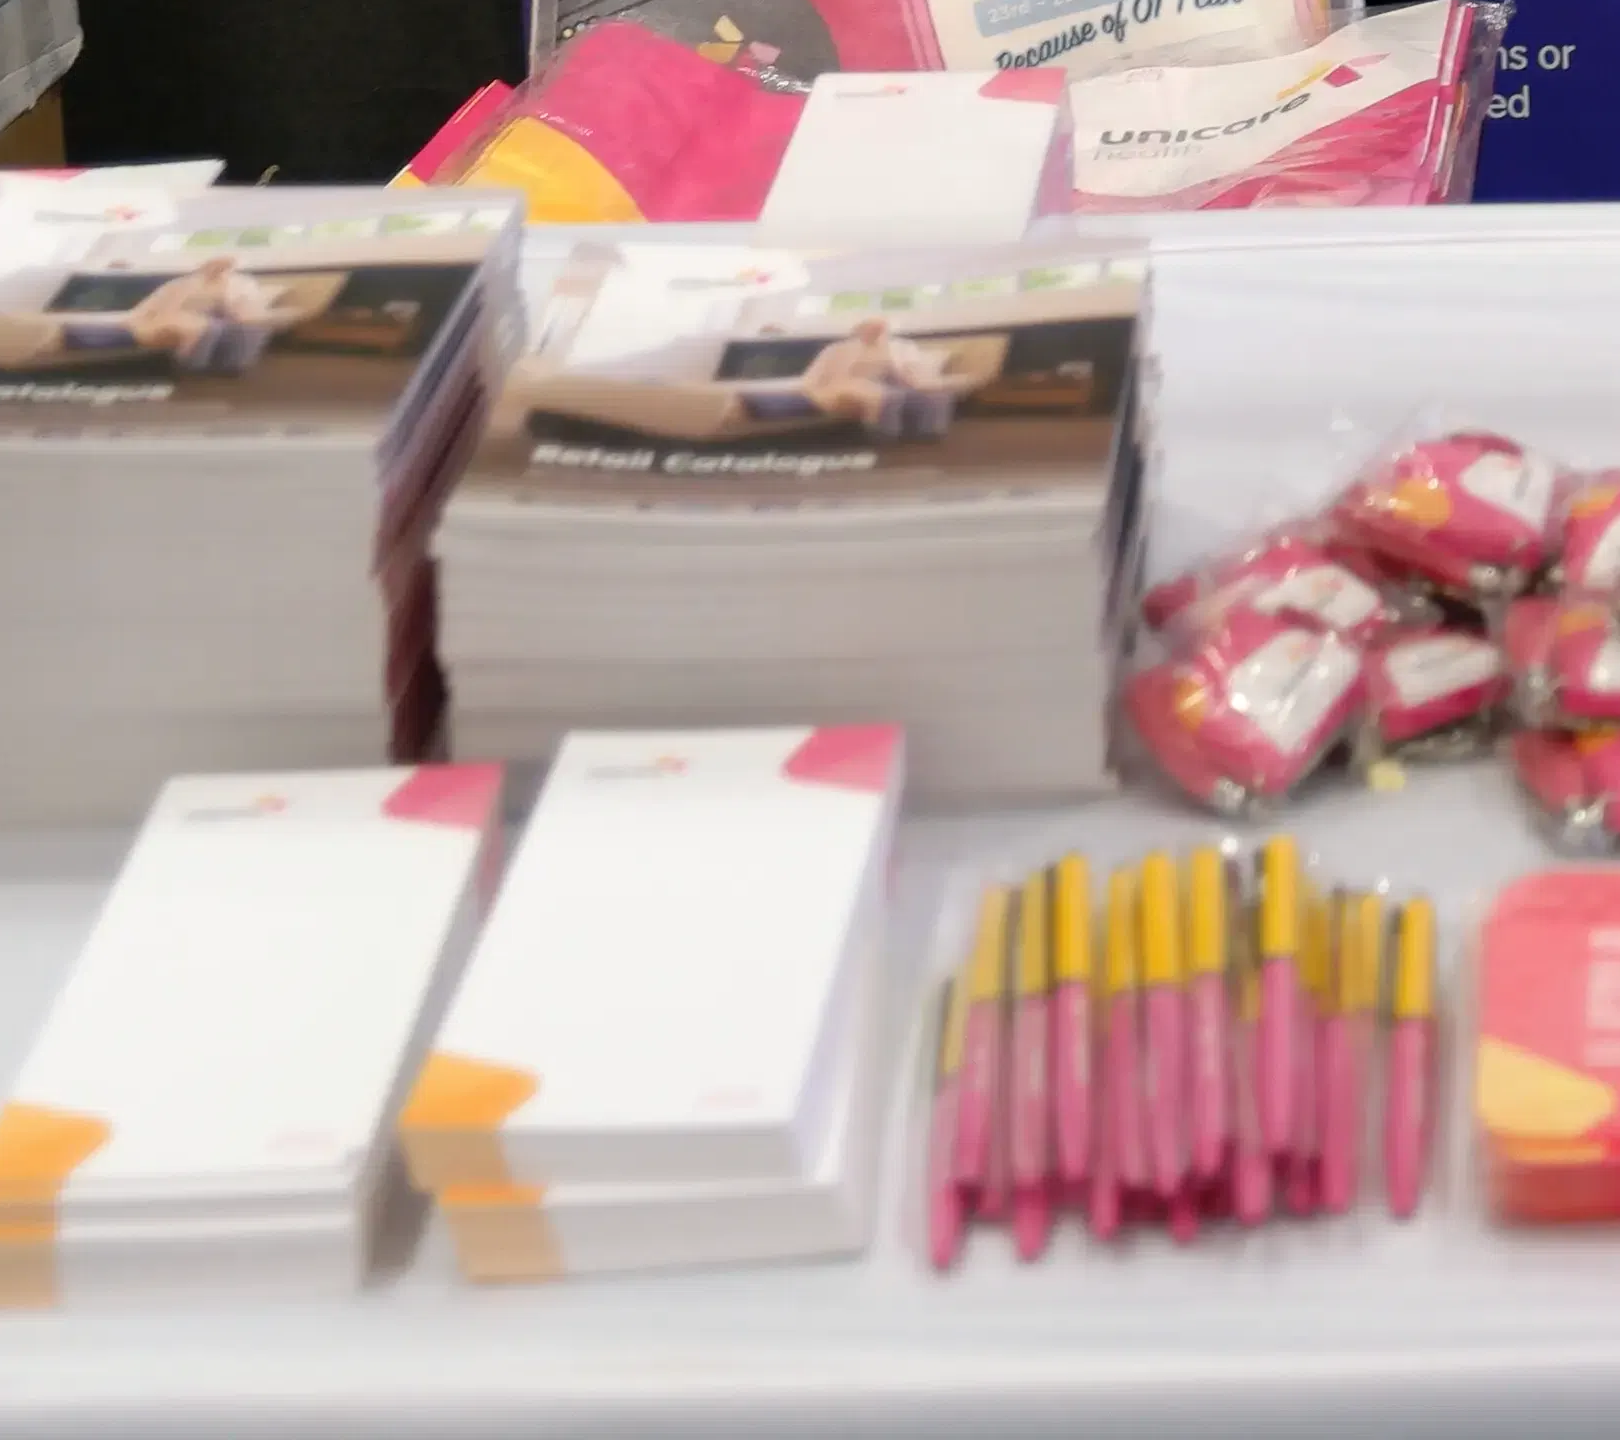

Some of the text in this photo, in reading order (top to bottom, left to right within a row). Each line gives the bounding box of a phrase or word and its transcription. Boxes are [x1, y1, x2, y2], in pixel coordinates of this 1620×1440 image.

[994, 19, 1097, 71] Because
[1101, 0, 1127, 44] of
[1536, 42, 1577, 71] or
[1098, 91, 1312, 147] unicare
[661, 450, 879, 478] Catalogue
